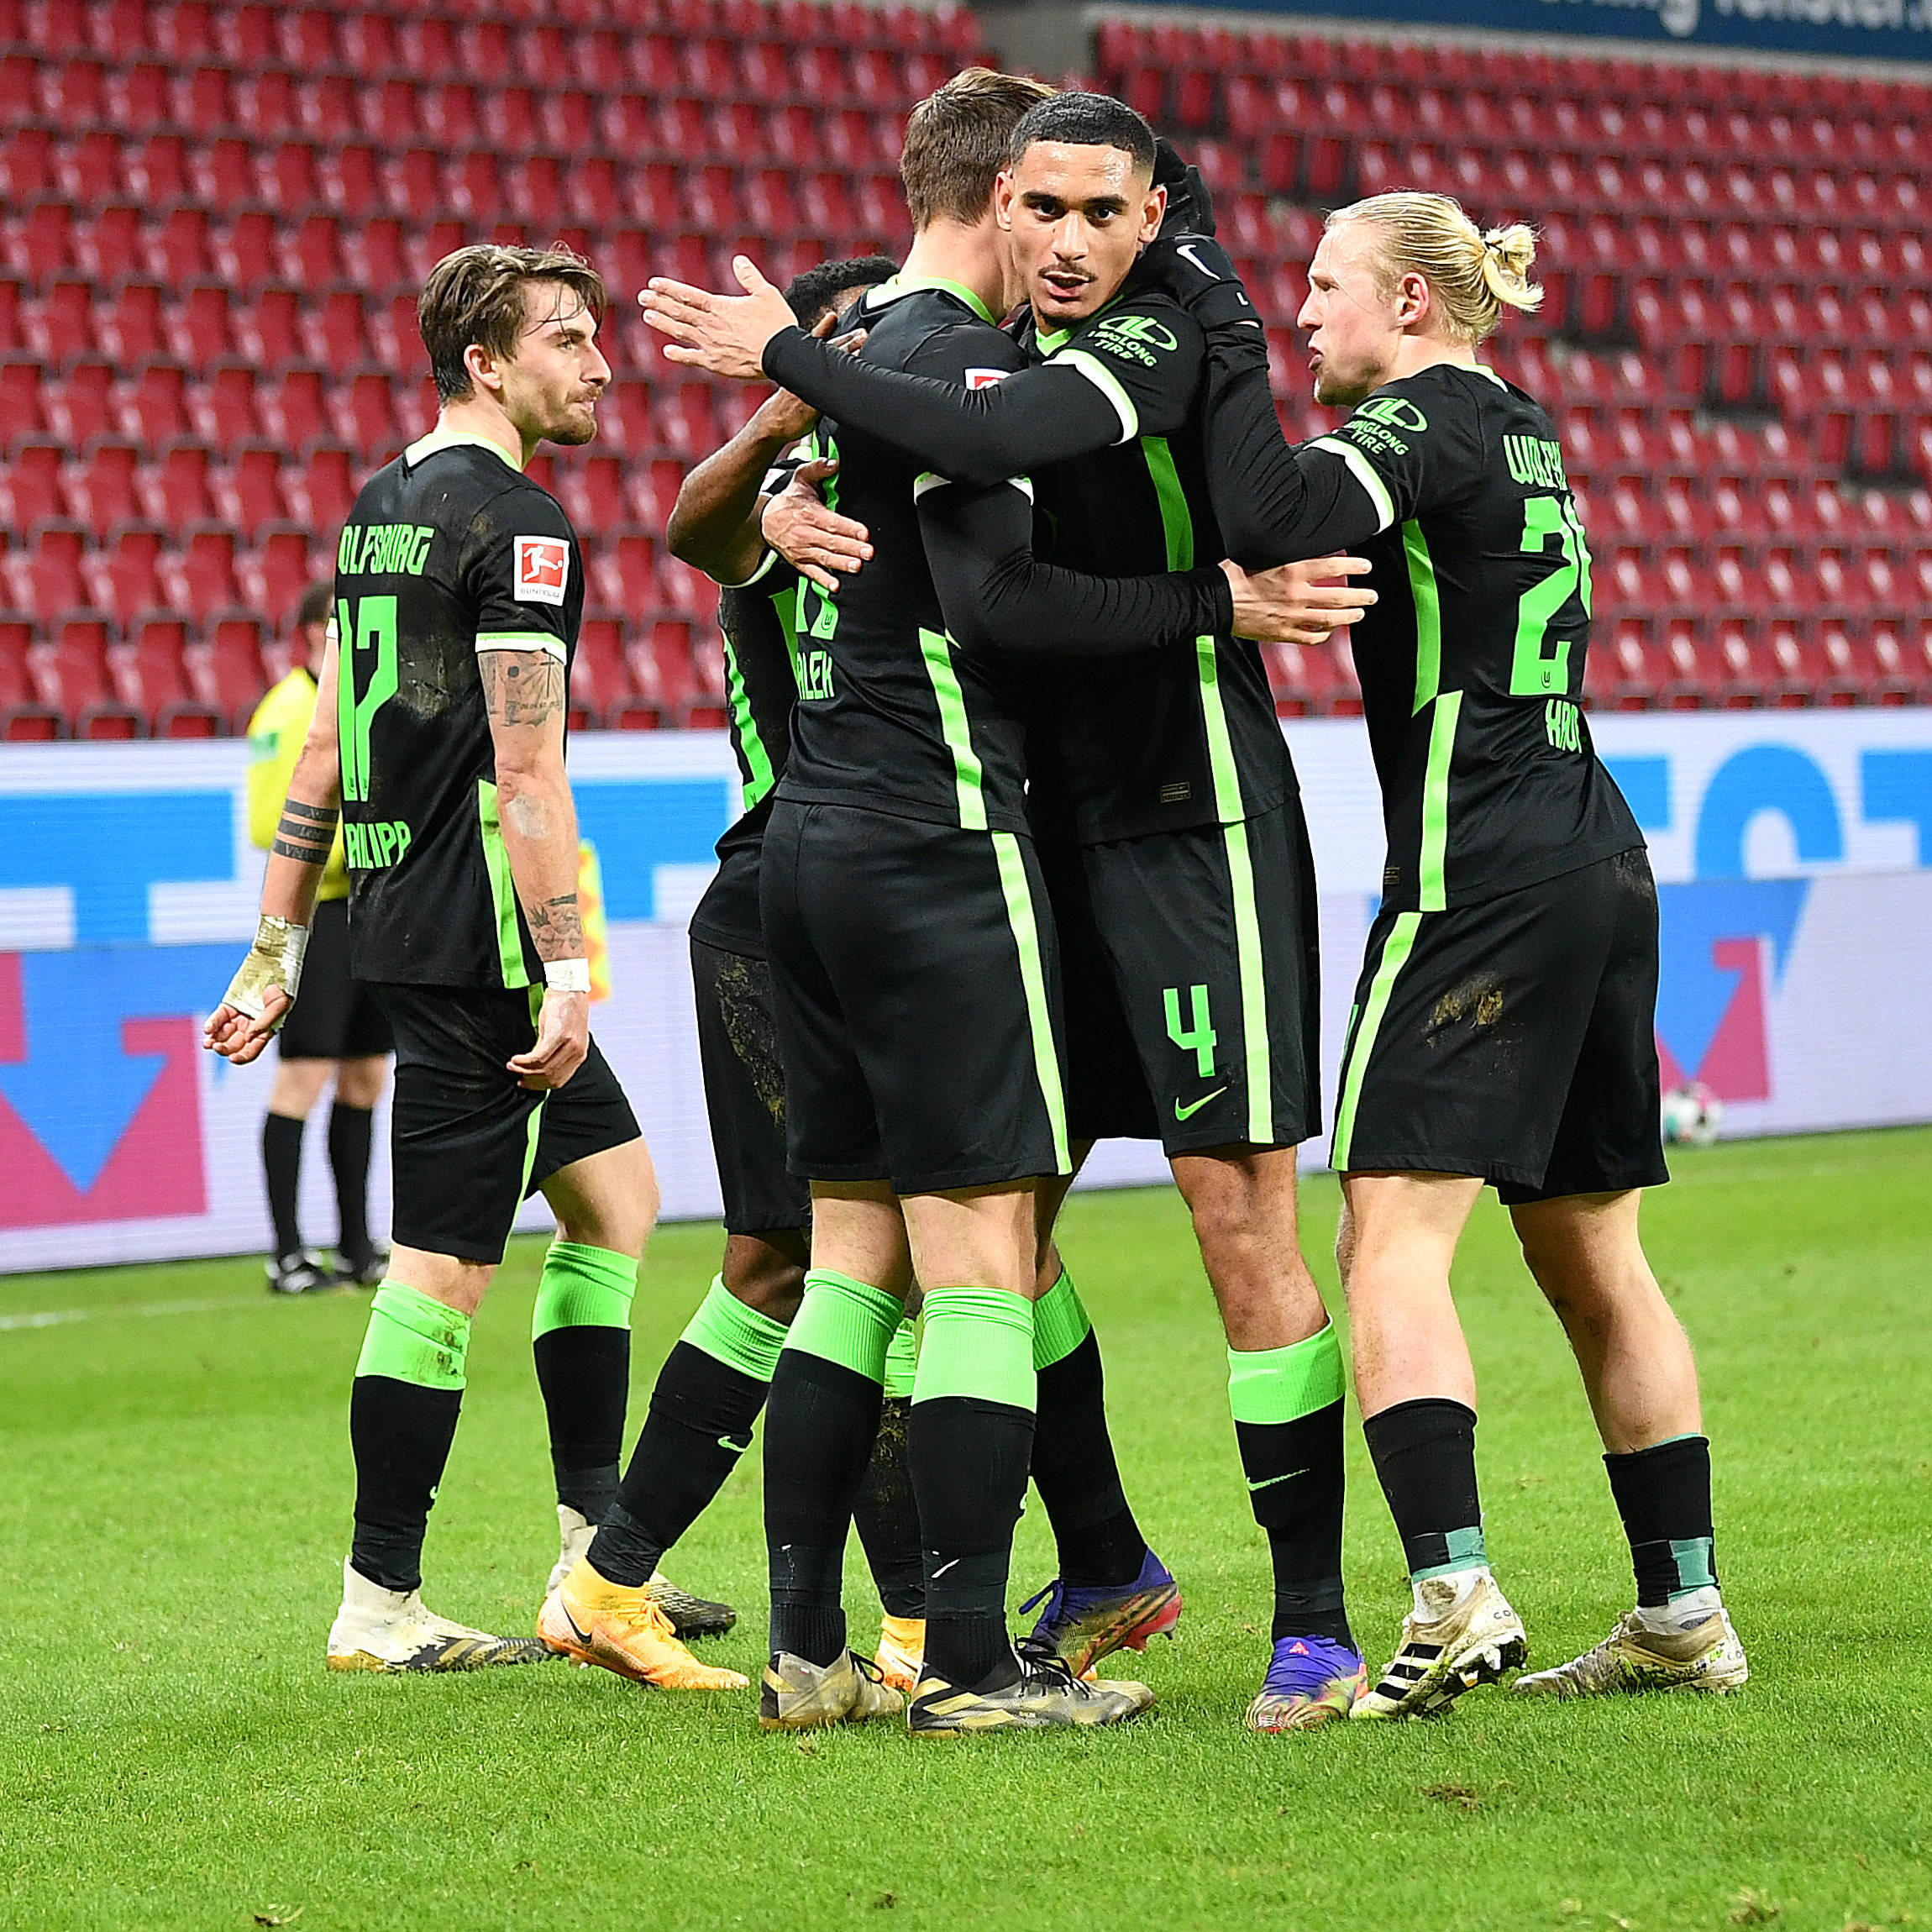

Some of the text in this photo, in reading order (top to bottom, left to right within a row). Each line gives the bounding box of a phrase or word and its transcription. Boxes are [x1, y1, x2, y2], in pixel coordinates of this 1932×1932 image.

[1351, 429, 1388, 454] TIRE
[338, 523, 434, 575] OLFSBURG
[338, 595, 398, 802] 17
[797, 650, 835, 701] ALEK
[1163, 984, 1216, 1078] 4
